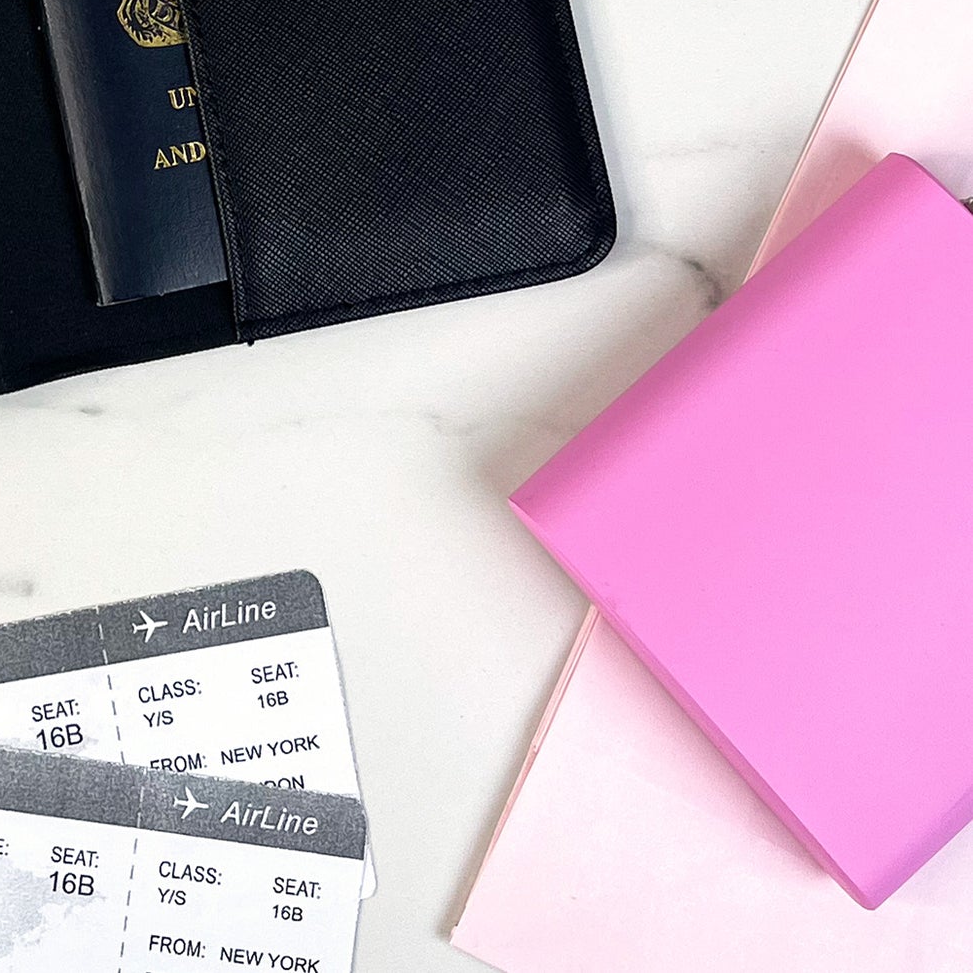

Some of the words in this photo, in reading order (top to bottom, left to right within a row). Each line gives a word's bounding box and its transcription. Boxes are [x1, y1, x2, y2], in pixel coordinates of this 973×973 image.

[154, 141, 206, 170] AND
[182, 600, 277, 634] AirLine
[251, 661, 300, 685] SEAT:
[138, 679, 202, 704] CLASS:
[257, 690, 289, 709] 16B
[31, 699, 80, 723] SEAT:
[143, 710, 174, 728] Y/S
[36, 723, 84, 750] 16B
[220, 744, 263, 765] NEW
[267, 734, 320, 757] YORK
[220, 801, 319, 836] AirLine
[51, 846, 100, 868] SEAT:
[49, 871, 95, 896] 16B
[158, 860, 223, 886] CLASS:
[157, 888, 187, 906] Y/S
[272, 877, 322, 899] SEAT:
[272, 904, 303, 922] 16B
[148, 934, 206, 959] FROM:
[219, 946, 264, 967] NEW
[267, 952, 320, 973] YORK
